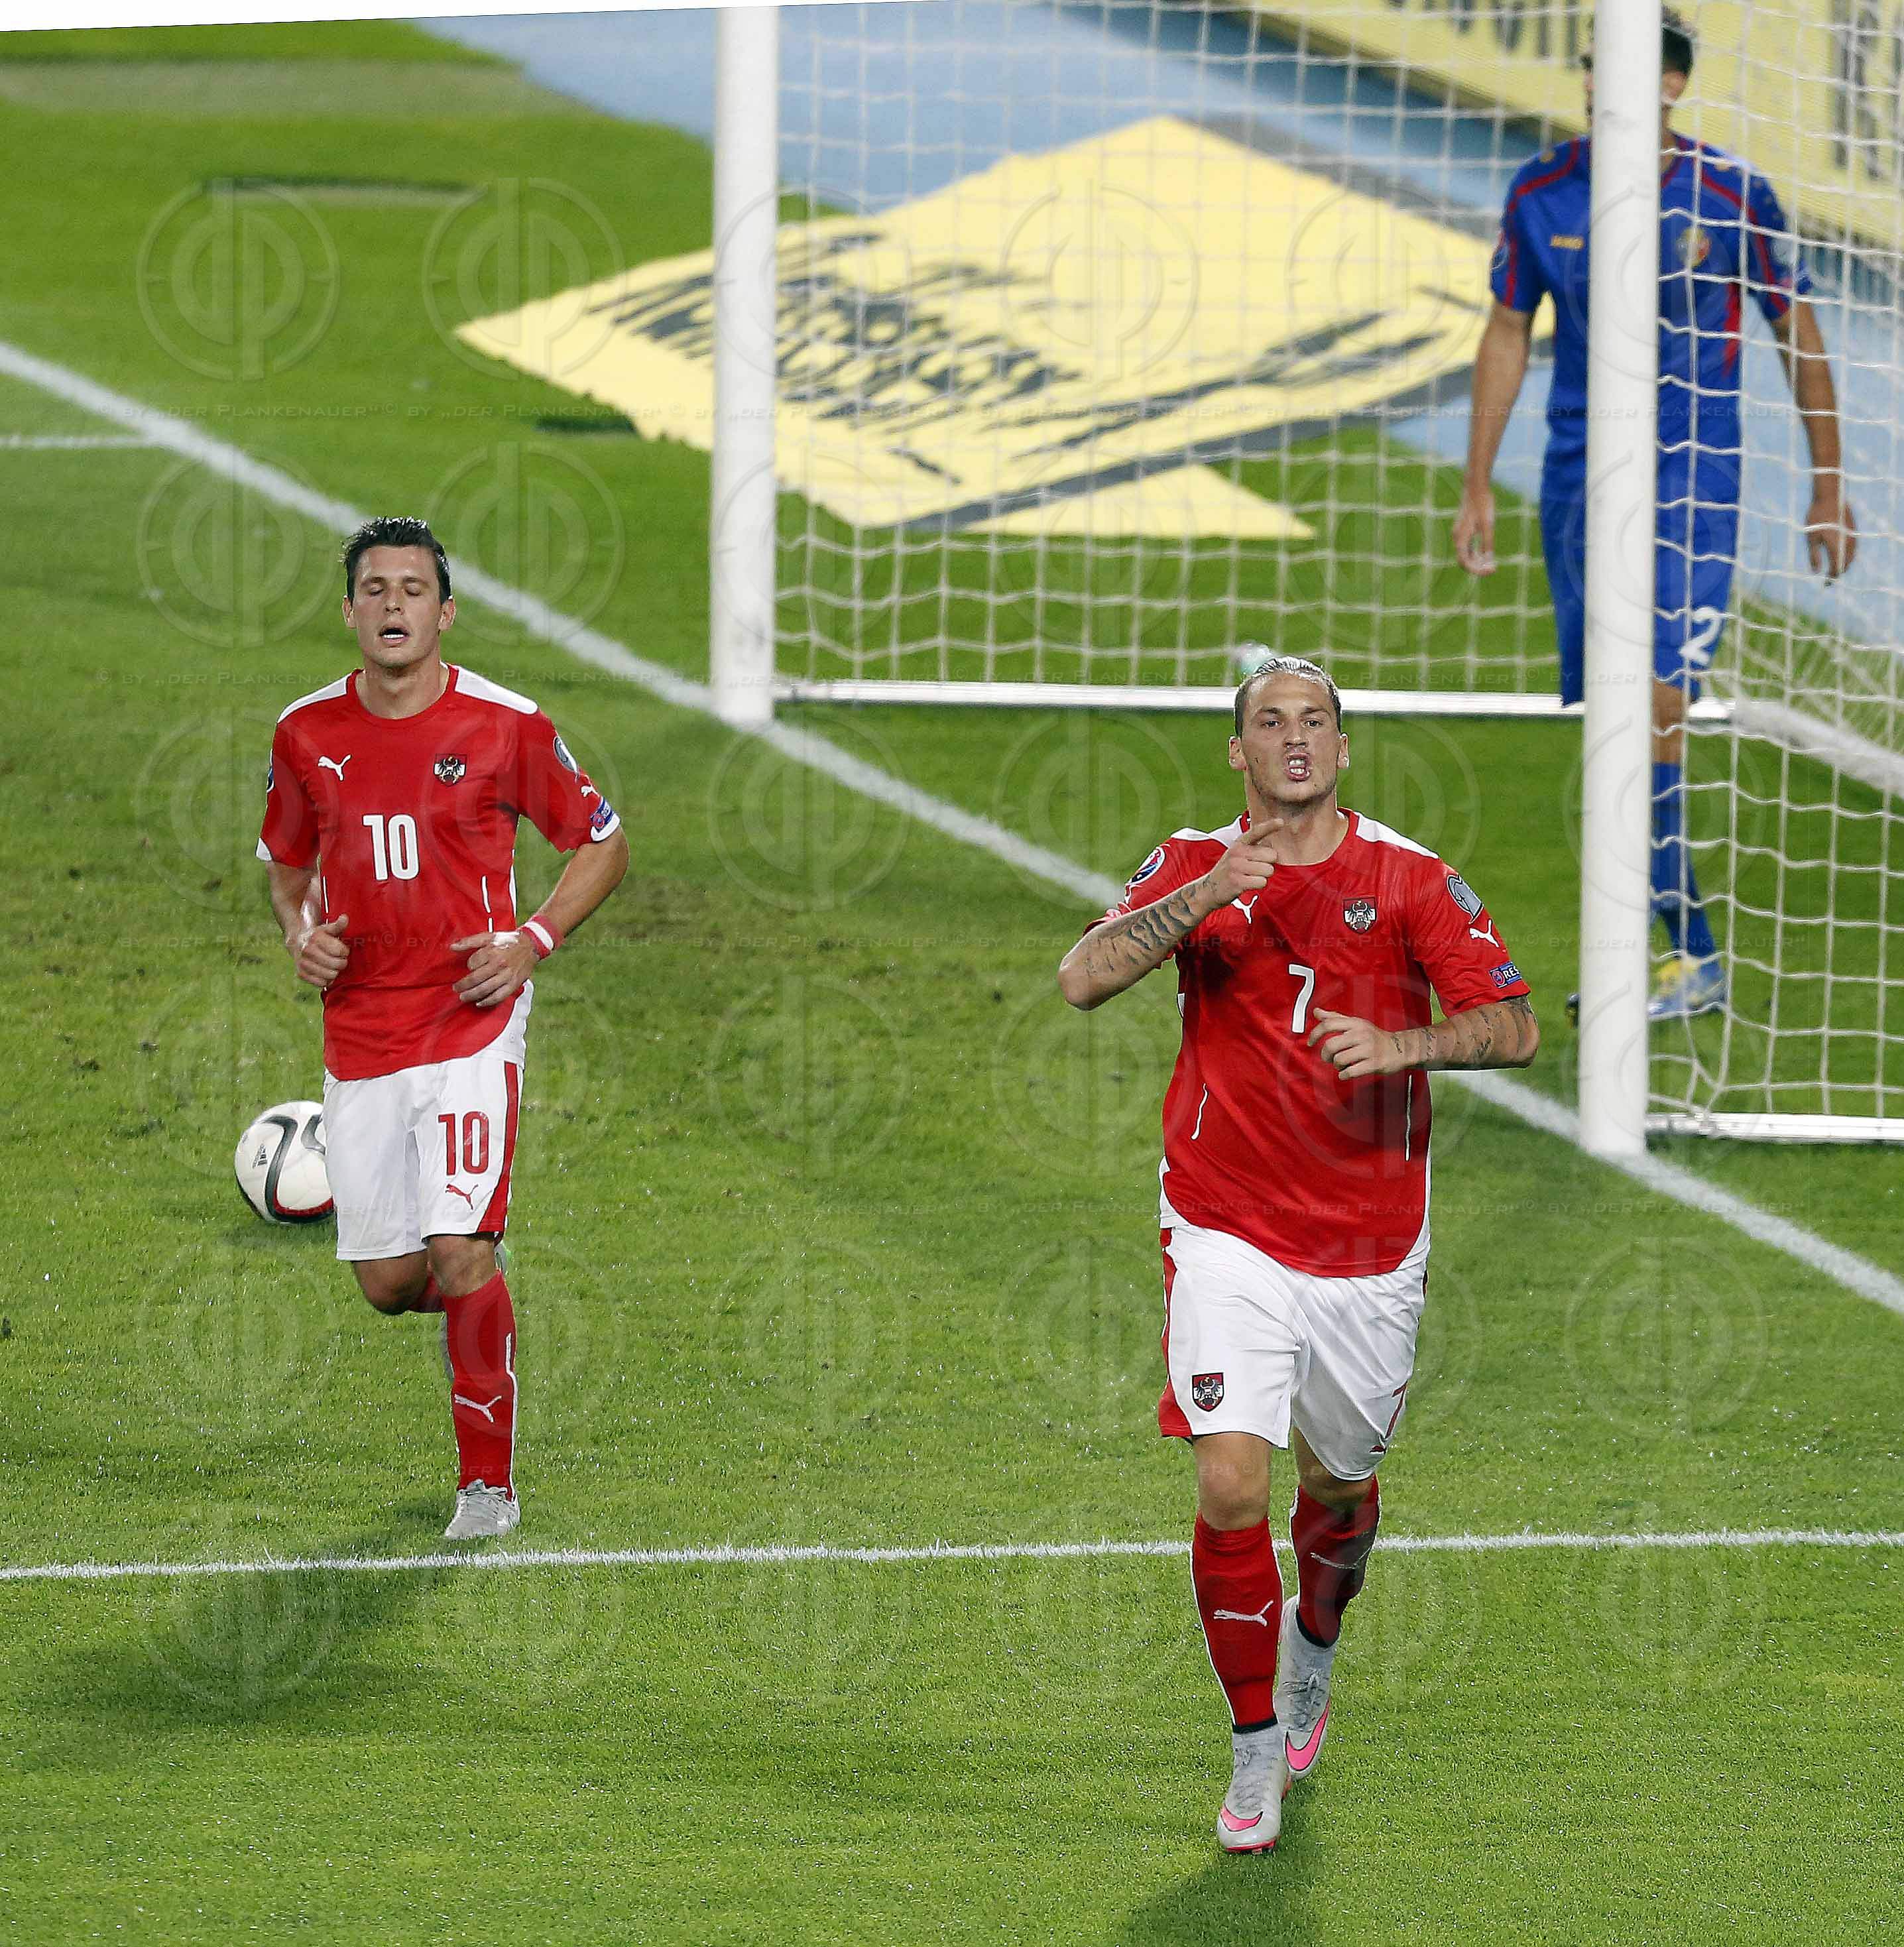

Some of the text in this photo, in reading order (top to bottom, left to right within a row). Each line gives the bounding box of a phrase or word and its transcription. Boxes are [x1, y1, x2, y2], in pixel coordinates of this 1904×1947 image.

[1679, 605, 1725, 666] 2
[363, 814, 419, 881] 10
[1288, 964, 1315, 1033] 7
[438, 1111, 489, 1176] 10
